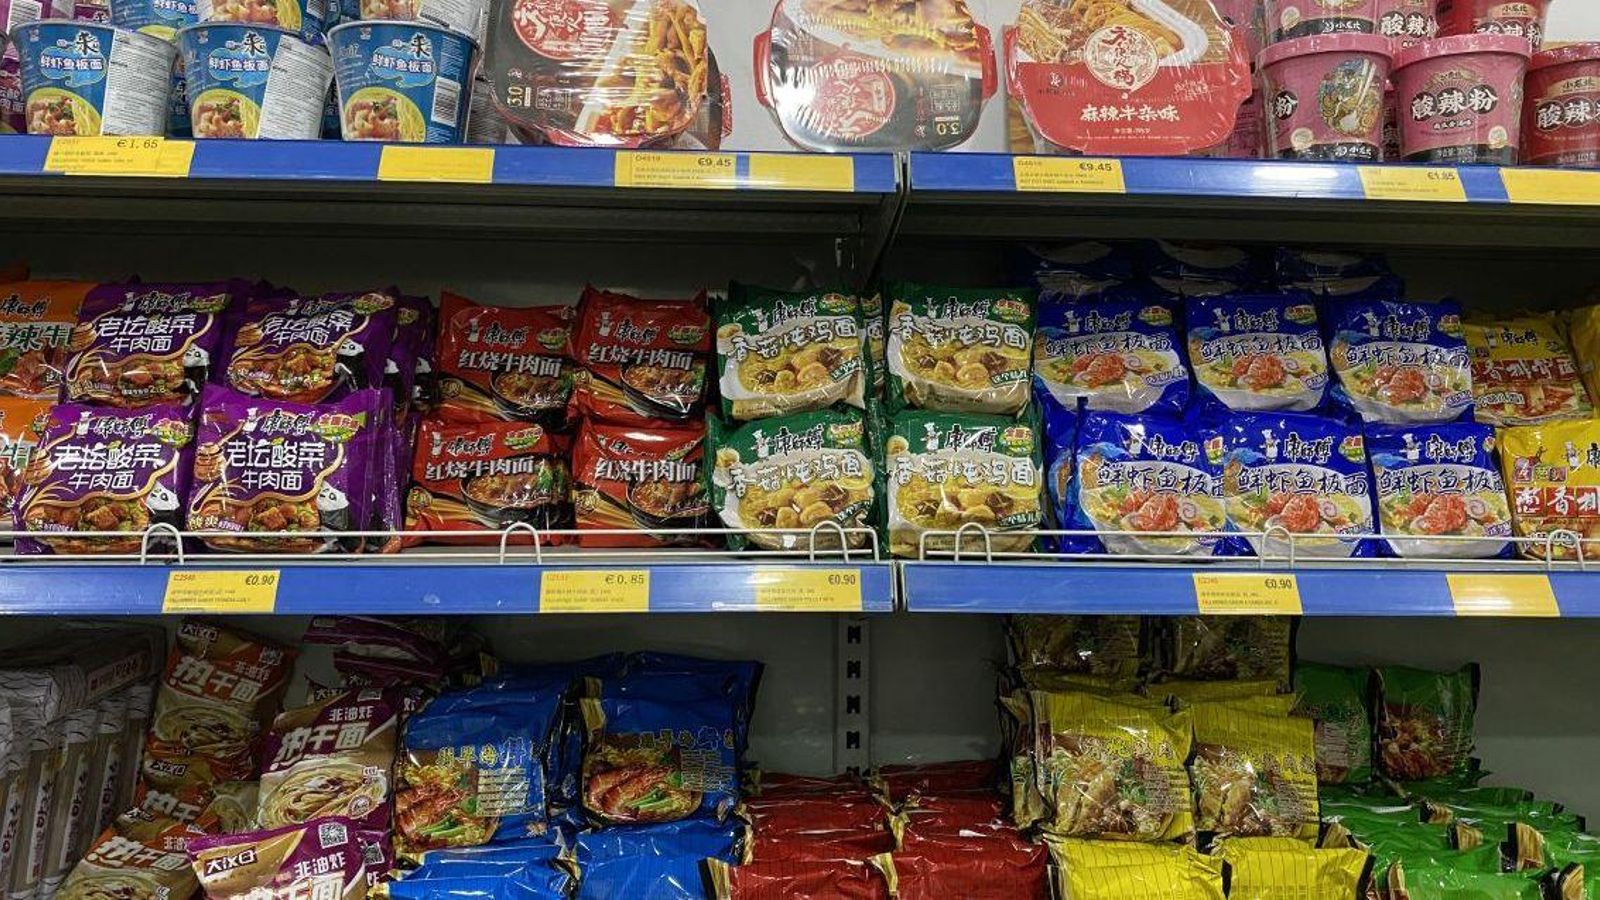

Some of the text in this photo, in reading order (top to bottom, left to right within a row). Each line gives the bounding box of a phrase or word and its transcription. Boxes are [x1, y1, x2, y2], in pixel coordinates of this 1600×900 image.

[1080, 103, 1180, 122] 麻辣牛杂味
[1411, 84, 1499, 121] 酸辣粉
[1537, 97, 1600, 129] 酸辣
[697, 156, 732, 168] €9.45
[1079, 162, 1112, 172] €9.45
[98, 314, 197, 337] 老坛酸菜
[110, 335, 173, 352] 牛肉面
[458, 348, 562, 378] 红烧牛肉面
[588, 342, 694, 371] 红烧牛肉面
[54, 443, 166, 471] 老坛酸菜
[226, 439, 326, 469] 老坛酸菜
[68, 469, 135, 490] 牛肉面
[241, 469, 303, 491] 牛肉面
[425, 456, 536, 480] 红烧牛肉面
[1237, 467, 1368, 497] 鲜虾鱼板面
[245, 574, 275, 586] €0.90
[828, 574, 856, 586] €0.90
[1265, 578, 1293, 589] €0.90
[169, 655, 263, 702] 热干面
[328, 705, 375, 722] 非油炸
[269, 721, 371, 771] 热干面
[87, 836, 191, 870] 热干面
[293, 851, 347, 879] 非油炸
